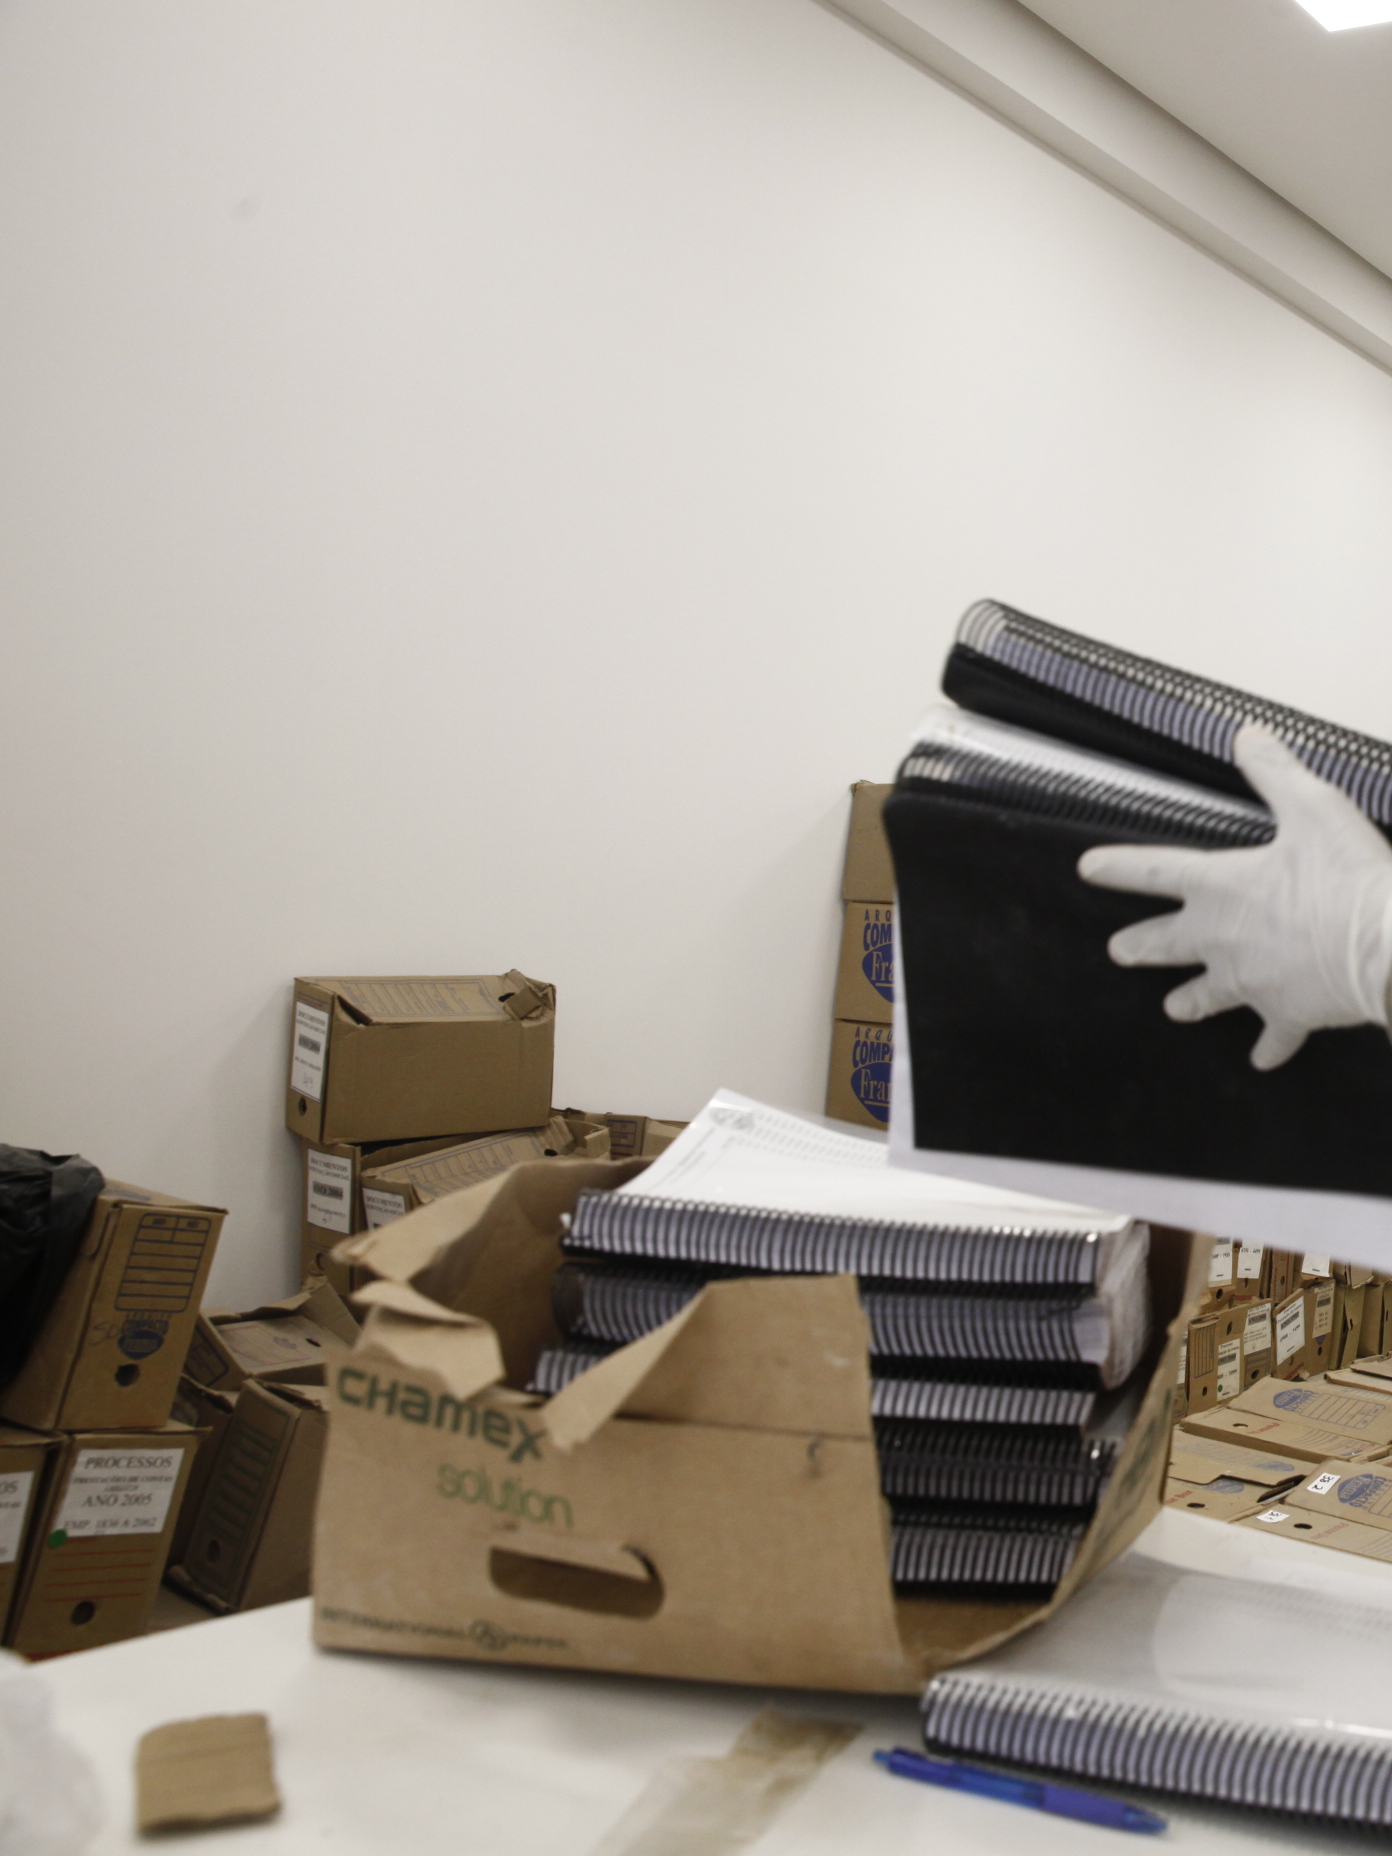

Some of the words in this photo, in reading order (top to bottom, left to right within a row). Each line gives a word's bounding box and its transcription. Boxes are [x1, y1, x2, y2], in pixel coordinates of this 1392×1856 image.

[863, 923, 895, 951] COM
[871, 951, 894, 981] Fra
[84, 1456, 173, 1469] PROCESSOS
[82, 1494, 119, 1507] ANO
[437, 1463, 573, 1528] solution
